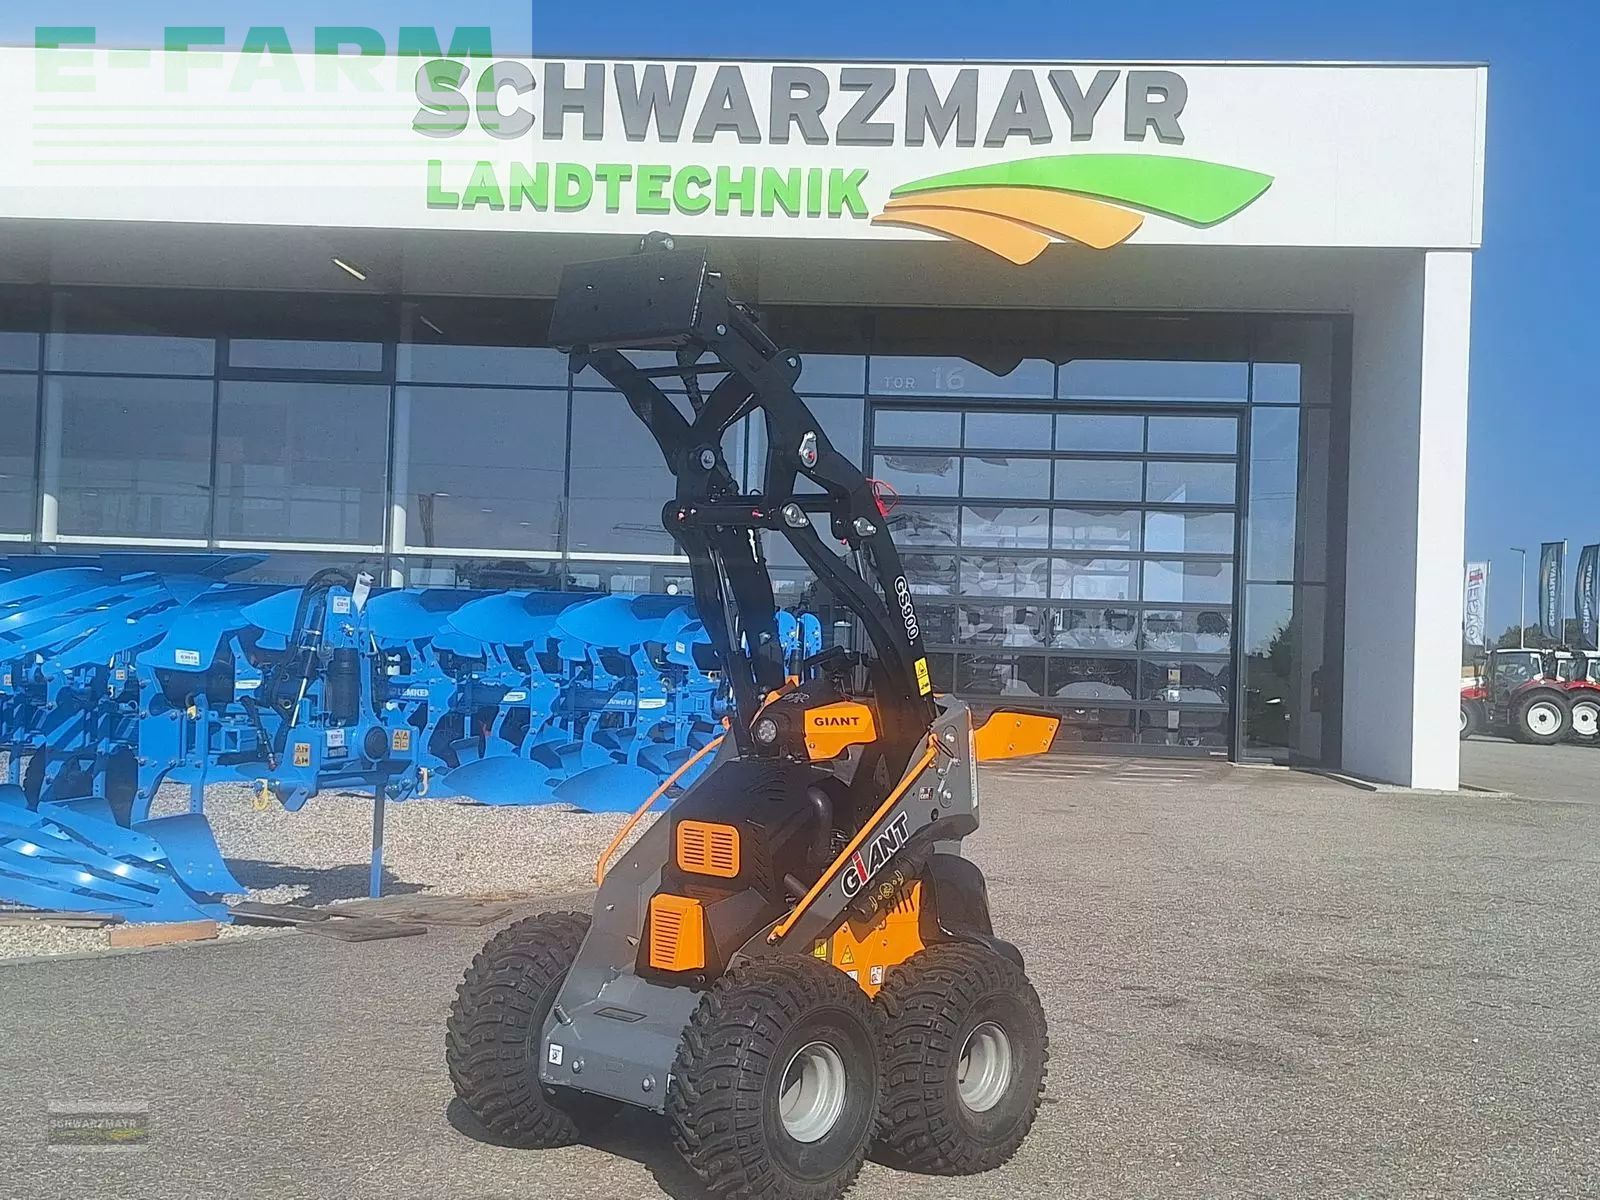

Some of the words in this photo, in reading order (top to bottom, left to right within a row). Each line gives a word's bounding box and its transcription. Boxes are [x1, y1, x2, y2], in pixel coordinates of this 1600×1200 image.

[412, 58, 1188, 148] SCHWARZMAYR
[427, 159, 869, 219] LANDTECHNIK
[883, 376, 916, 389] TOR
[931, 366, 965, 390] 16
[894, 575, 919, 639] GS900
[814, 716, 860, 727] GIANT
